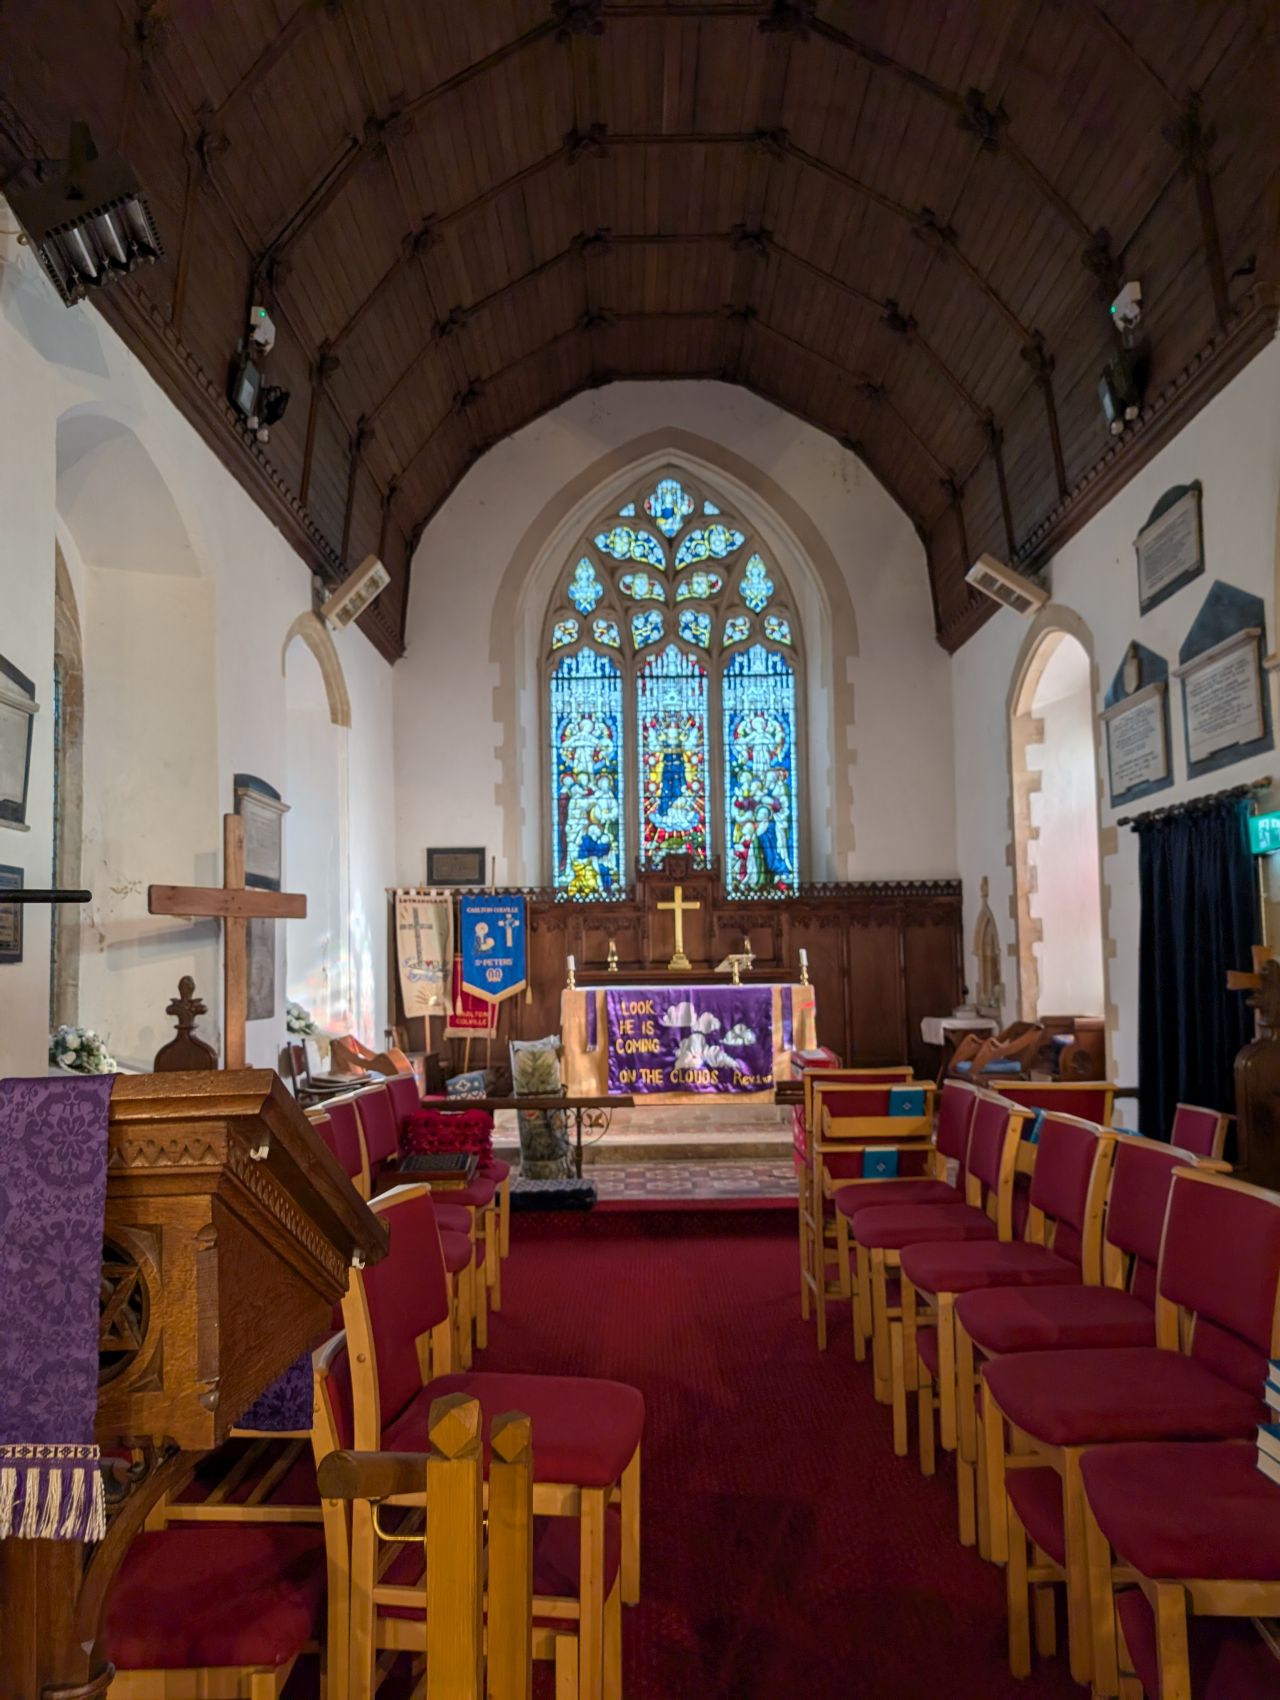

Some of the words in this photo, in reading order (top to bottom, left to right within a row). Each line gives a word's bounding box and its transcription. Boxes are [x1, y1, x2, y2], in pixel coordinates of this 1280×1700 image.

[460, 1010, 489, 1018] ARLTON
[621, 1000, 656, 1015] LOOK
[620, 1019, 635, 1035] HE
[641, 1020, 655, 1035] IS
[615, 1038, 660, 1055] COMING
[619, 1069, 637, 1084] ON
[639, 1068, 664, 1085] THE
[670, 1069, 719, 1085] CLOUDS
